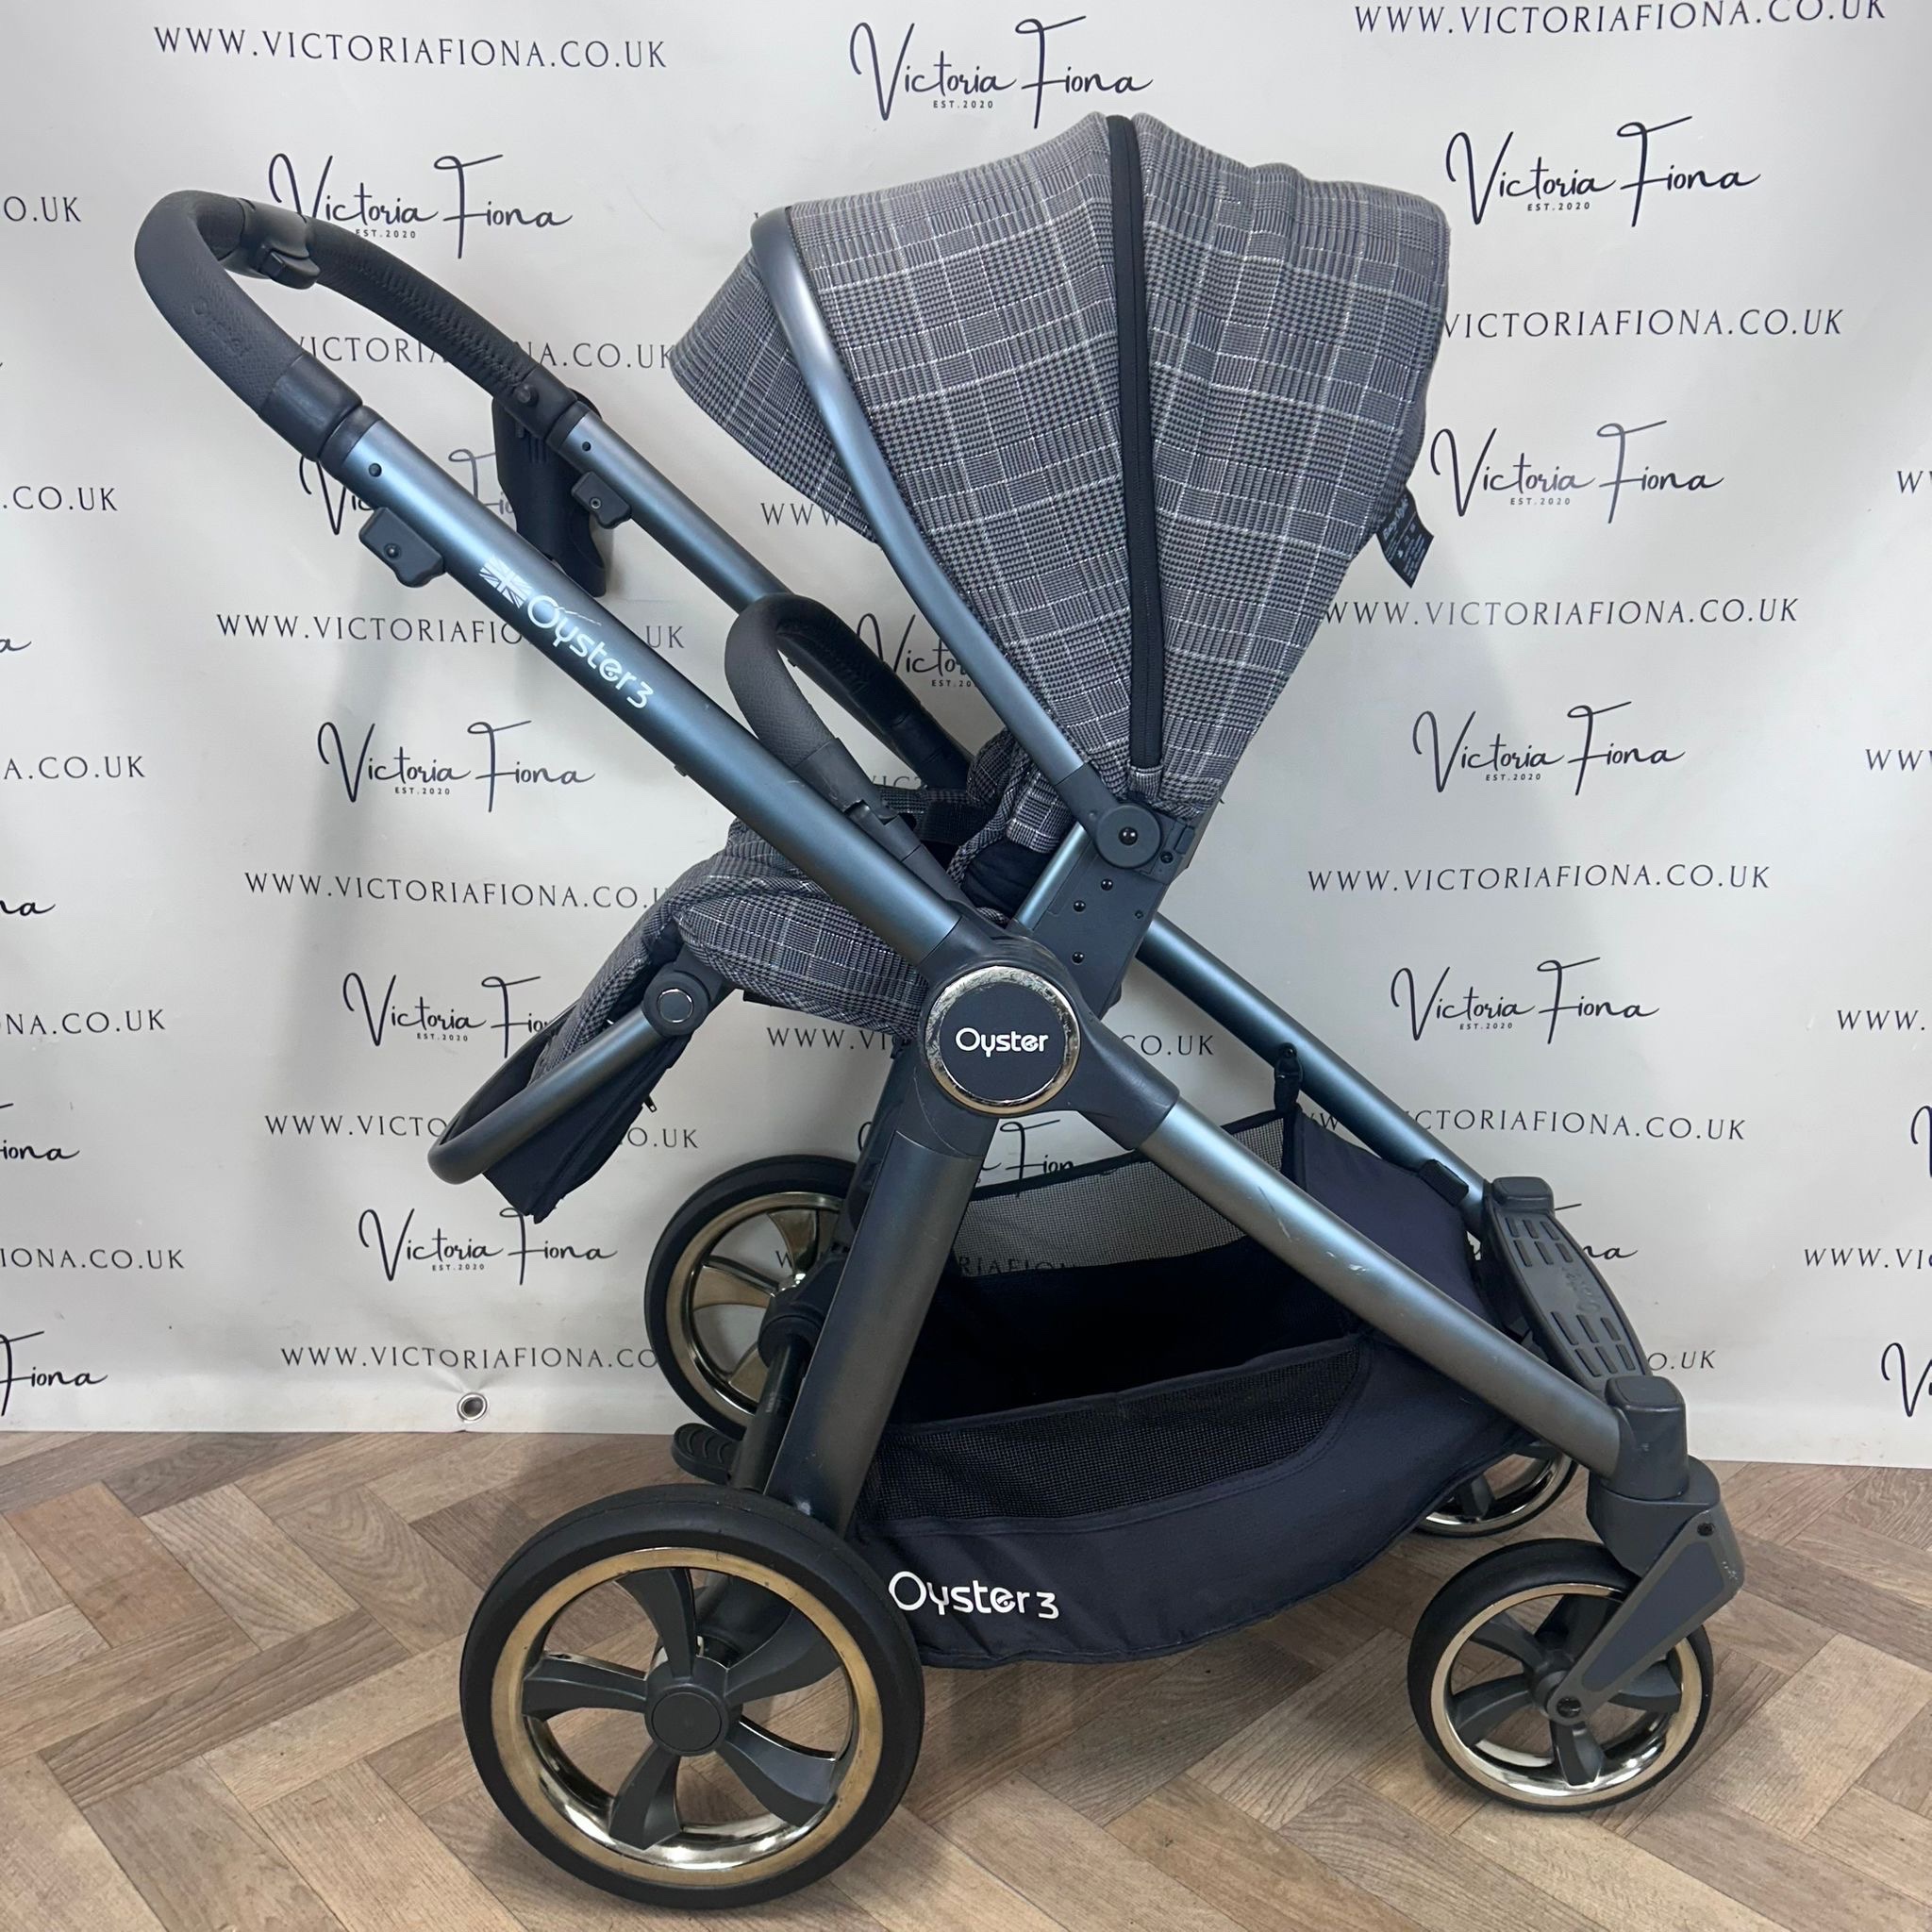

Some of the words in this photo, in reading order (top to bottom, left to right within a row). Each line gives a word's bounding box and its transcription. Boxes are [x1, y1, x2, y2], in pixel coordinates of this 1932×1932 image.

[1355, 0, 1887, 34] WWW.VICTORIAFIONA.CO.UK
[155, 26, 665, 68] WWW.VICTORIAFIONA.CO.UK
[850, 23, 1017, 121] Victoria
[1016, 16, 1153, 129] Fiona
[933, 100, 993, 109] EST.2020
[1446, 131, 1617, 225] Victoria
[1617, 115, 1760, 227] Fiona
[268, 154, 437, 225] Victoria
[435, 155, 572, 258] Fiona
[1527, 201, 1591, 210] EST.2020
[1430, 427, 1597, 518] Victoria
[1596, 420, 1724, 525] Fiona
[1509, 496, 1572, 507] EST.2020
[1323, 598, 1798, 625] WWW.VICTORIAFIONA.CO.UK
[527, 595, 637, 690] Oyster
[318, 721, 472, 804] Victoria
[467, 720, 595, 813] Fiona
[1412, 711, 1567, 793] Victoria
[1567, 701, 1686, 796] Fiona
[394, 786, 451, 795] EST.2020
[1485, 773, 1542, 782] EST.2020
[1307, 865, 1771, 891] WWW.VICTORIAFIONA.CO.UK
[343, 973, 486, 1047] Victoria
[1391, 967, 1540, 1041] Victoria
[1538, 958, 1659, 1045] Fiona
[416, 1032, 470, 1042] EST.2020
[955, 1028, 1049, 1059] Oyster
[1458, 1022, 1514, 1032] EST.2020
[359, 1208, 503, 1282] Victoria
[500, 1208, 617, 1286] Fiona
[431, 1263, 485, 1273] EST.2020
[889, 1571, 1030, 1615] Oyster
